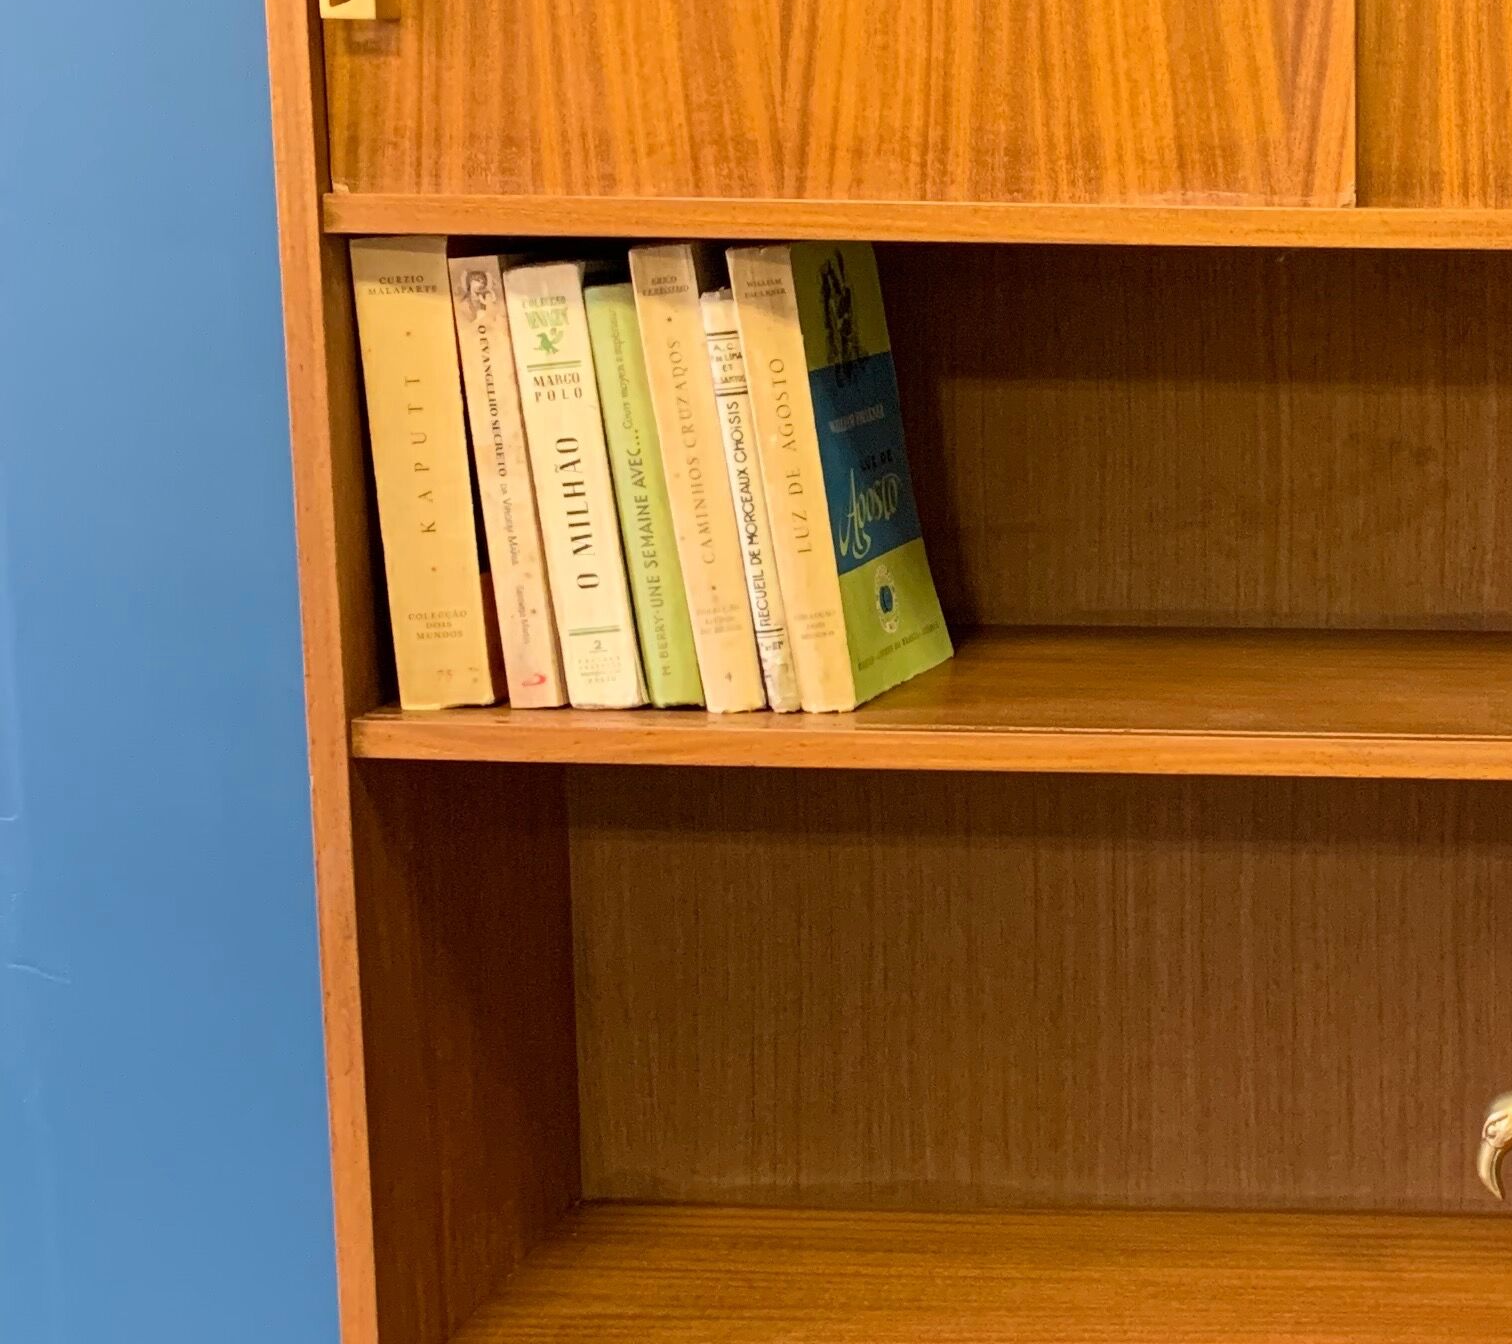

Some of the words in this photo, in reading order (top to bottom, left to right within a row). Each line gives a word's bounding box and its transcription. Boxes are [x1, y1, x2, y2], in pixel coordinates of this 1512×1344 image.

[368, 285, 437, 296] MALAPARTE
[378, 275, 424, 285] CURZIO
[533, 372, 581, 388] MARCO
[534, 387, 583, 403] POLO
[668, 338, 696, 449] CRUZADOS
[769, 358, 798, 452] AGOSTO
[479, 336, 498, 417] EVANGELHO
[491, 418, 507, 477] SECRETO
[404, 375, 437, 533] KAPUTT
[554, 436, 596, 556] MILHÃO
[735, 466, 760, 546] MORCEAUX
[786, 468, 806, 496] DE
[634, 493, 657, 569] SEMAINE
[687, 455, 715, 565] CAMINHOS
[792, 512, 813, 554] LUZ
[576, 573, 600, 590] O
[747, 547, 763, 566] DE
[751, 569, 771, 628] RECUEIL
[416, 630, 464, 641] MUNDOS
